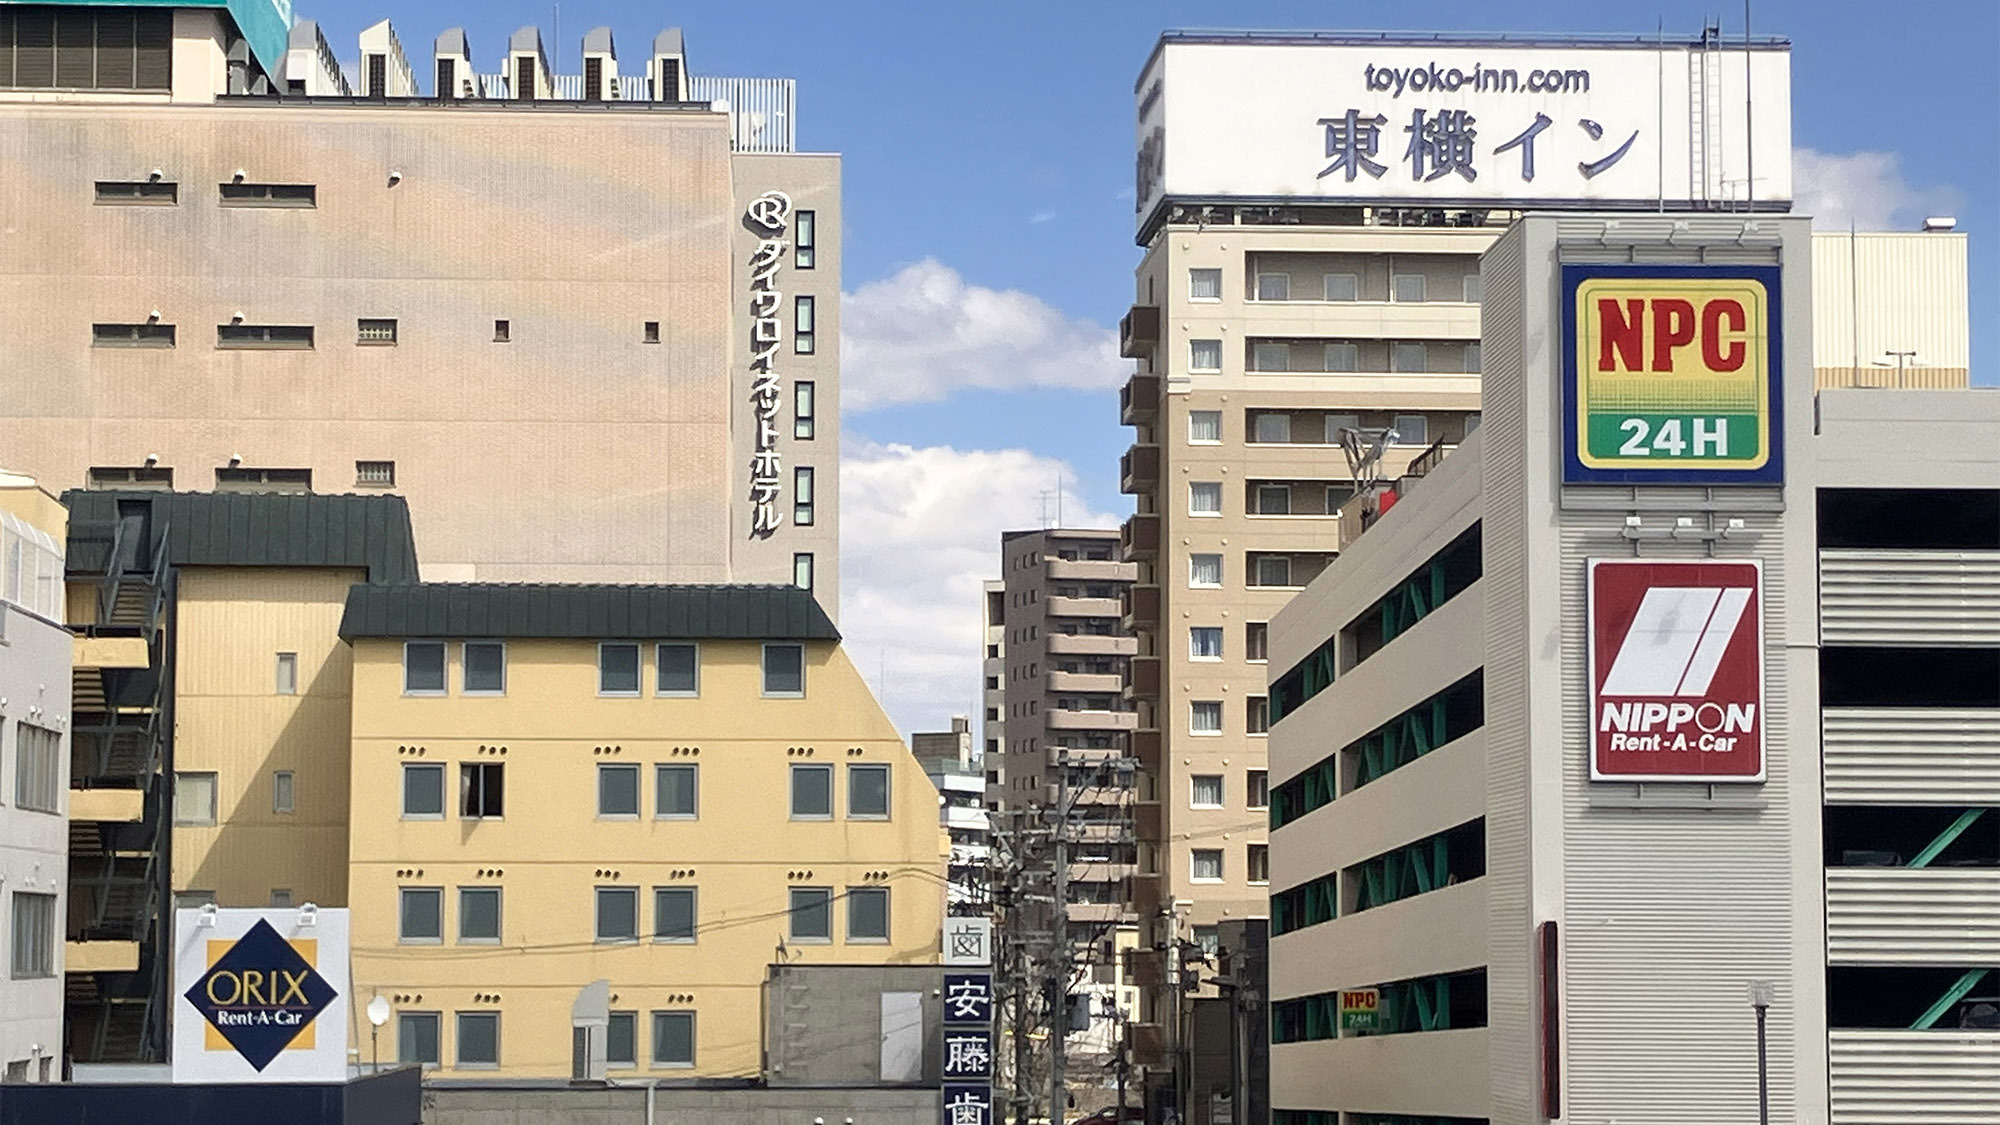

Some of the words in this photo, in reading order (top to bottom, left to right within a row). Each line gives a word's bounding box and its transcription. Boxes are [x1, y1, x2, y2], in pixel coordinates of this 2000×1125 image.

[1365, 61, 1590, 98] toyoko-inn.com
[1316, 108, 1639, 183] 東横イン
[1598, 298, 1746, 372] NPC
[753, 239, 791, 530] ダイワロイネットホテル
[1619, 418, 1728, 456] 24H
[1600, 702, 1755, 732] NIPPON
[1610, 733, 1738, 752] Rent-A-Car
[206, 970, 309, 1005] ORIX
[1342, 992, 1376, 1009] NPC
[218, 1010, 302, 1025] Rent-A-Car
